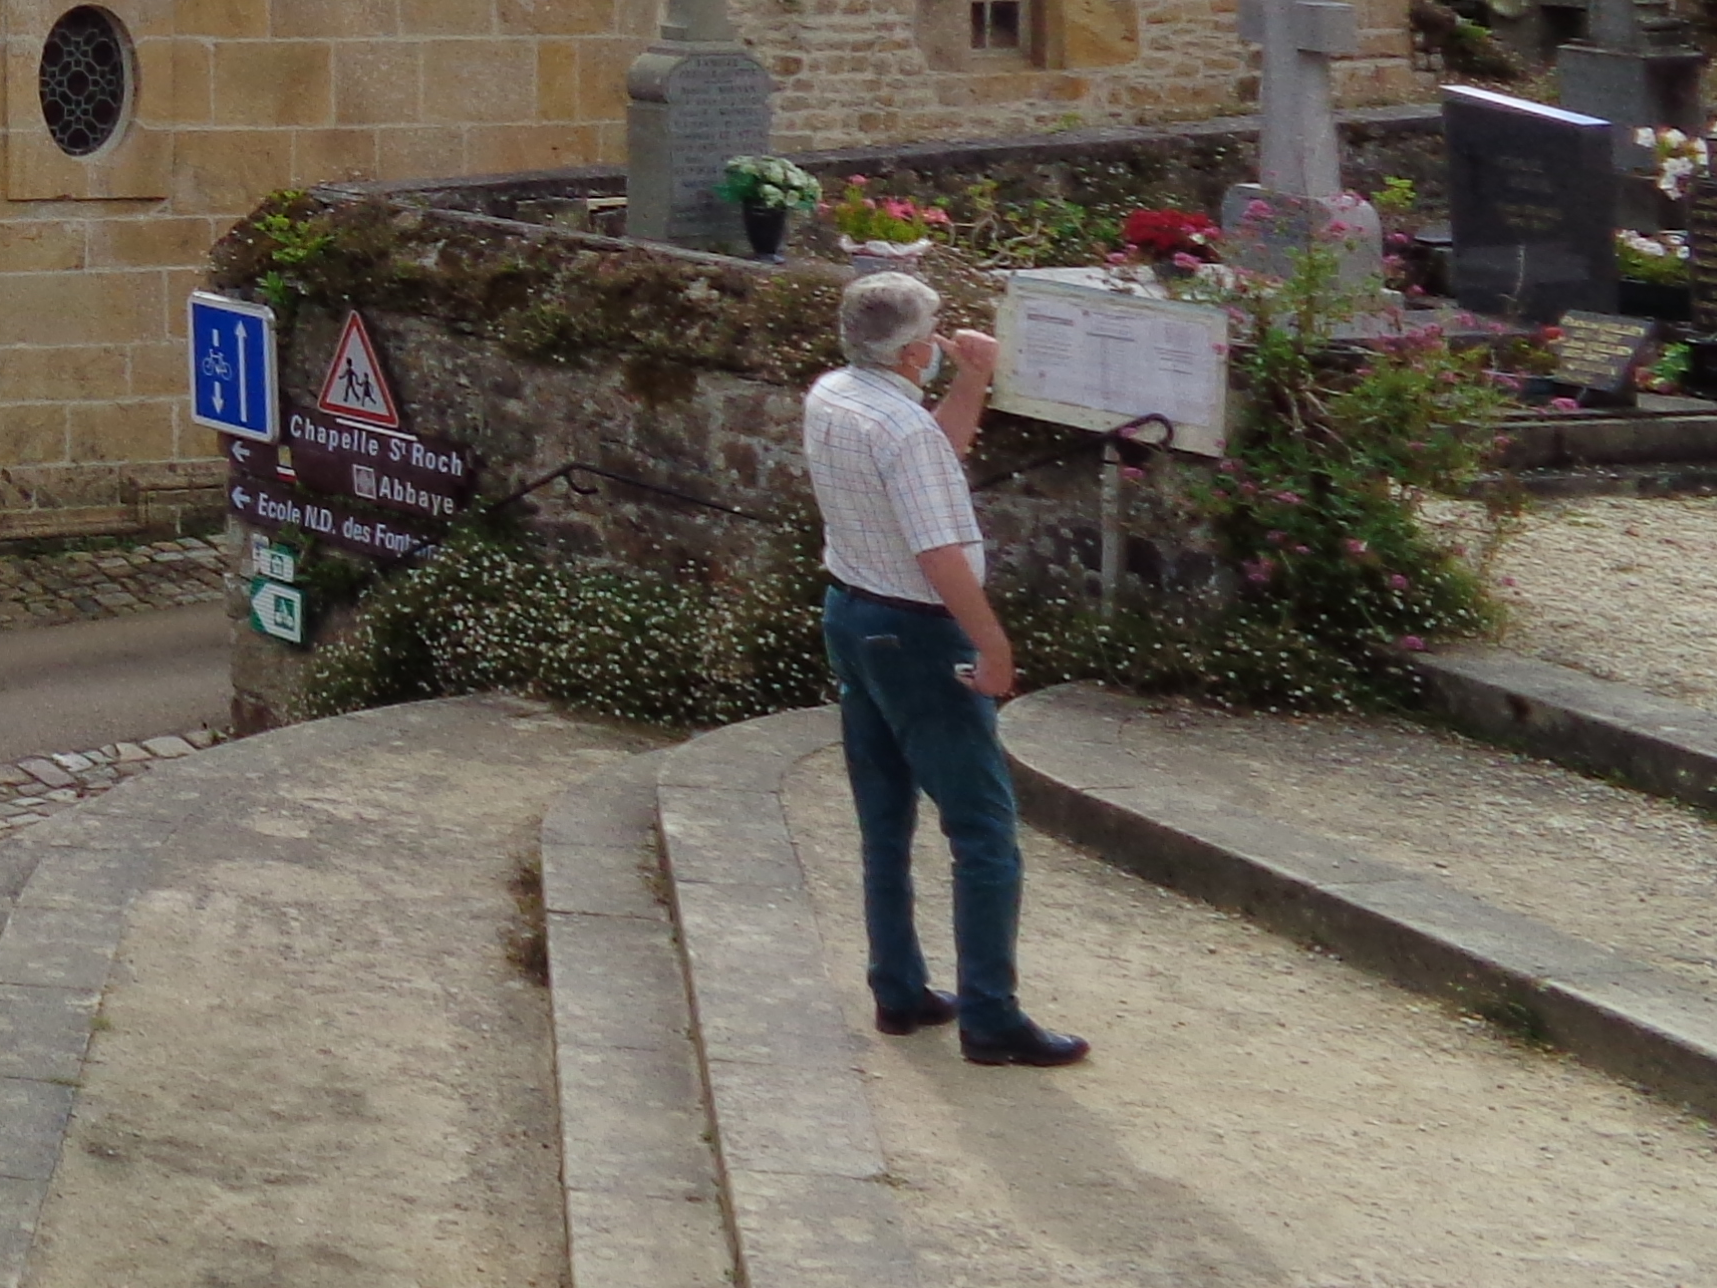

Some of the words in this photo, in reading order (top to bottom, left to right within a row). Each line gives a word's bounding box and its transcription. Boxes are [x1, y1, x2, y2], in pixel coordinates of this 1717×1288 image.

[290, 415, 380, 456] Chapelle
[390, 439, 406, 461] St
[412, 442, 463, 476] Roch
[258, 492, 301, 524] Ecole
[305, 504, 336, 535] N.D.
[343, 516, 371, 543] des
[379, 476, 454, 515] Abbaye
